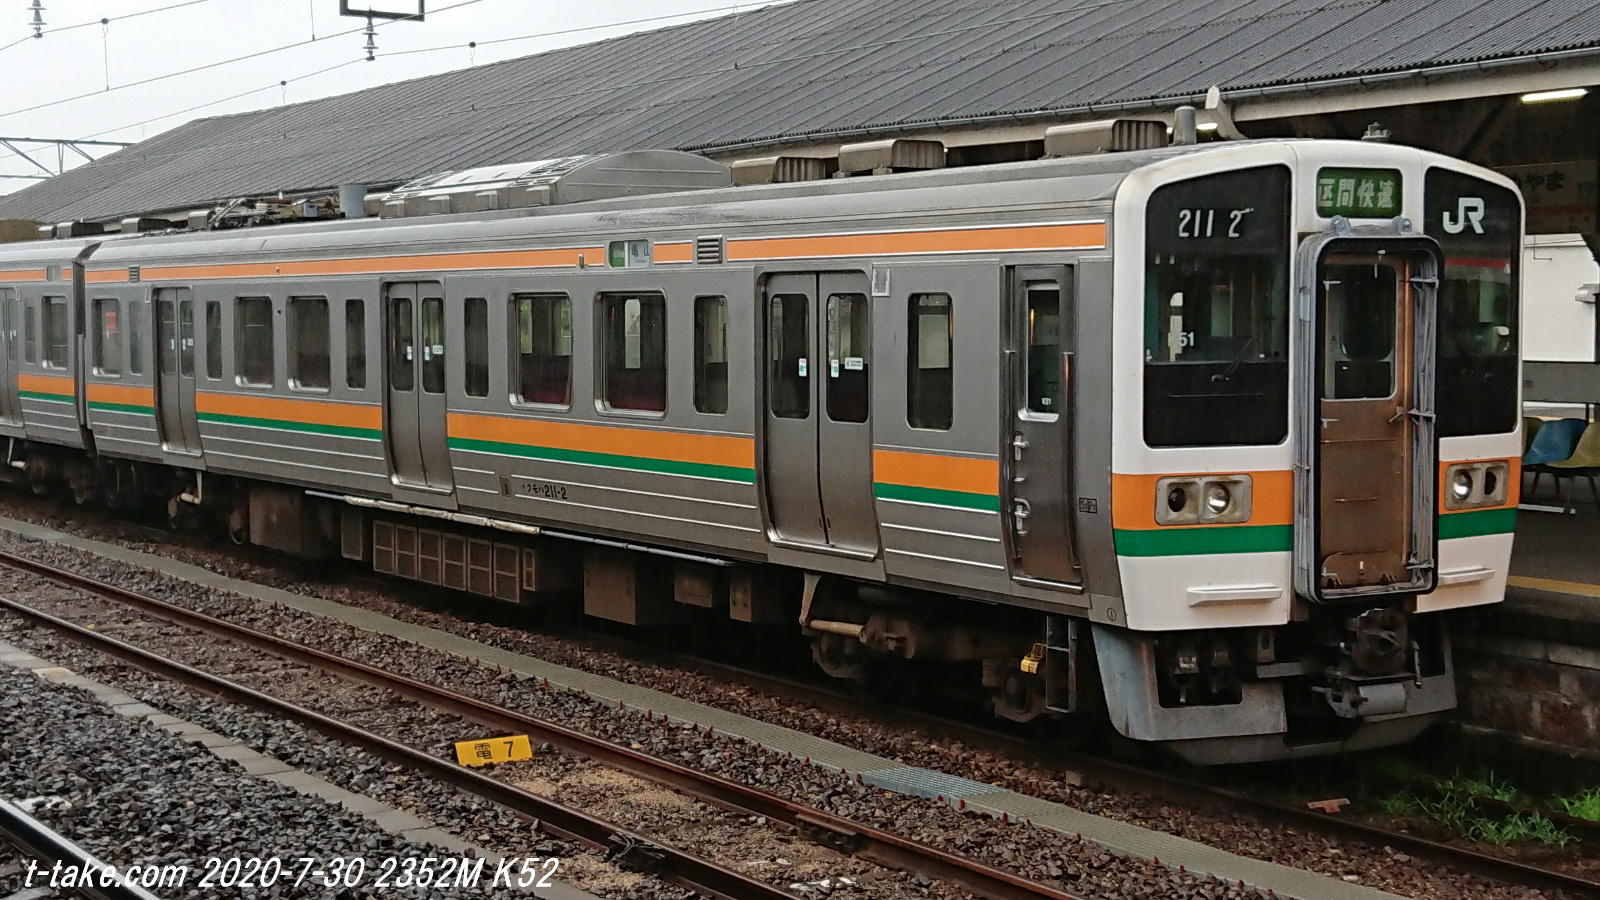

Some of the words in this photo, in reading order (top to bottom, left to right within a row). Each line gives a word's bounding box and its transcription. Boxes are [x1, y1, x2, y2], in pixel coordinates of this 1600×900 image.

[1318, 178, 1395, 208] 区間快速
[1178, 209, 1214, 238] 211
[1228, 209, 1242, 238] 2
[1442, 197, 1485, 234] JR
[474, 743, 493, 760] 電
[503, 740, 514, 758] 7
